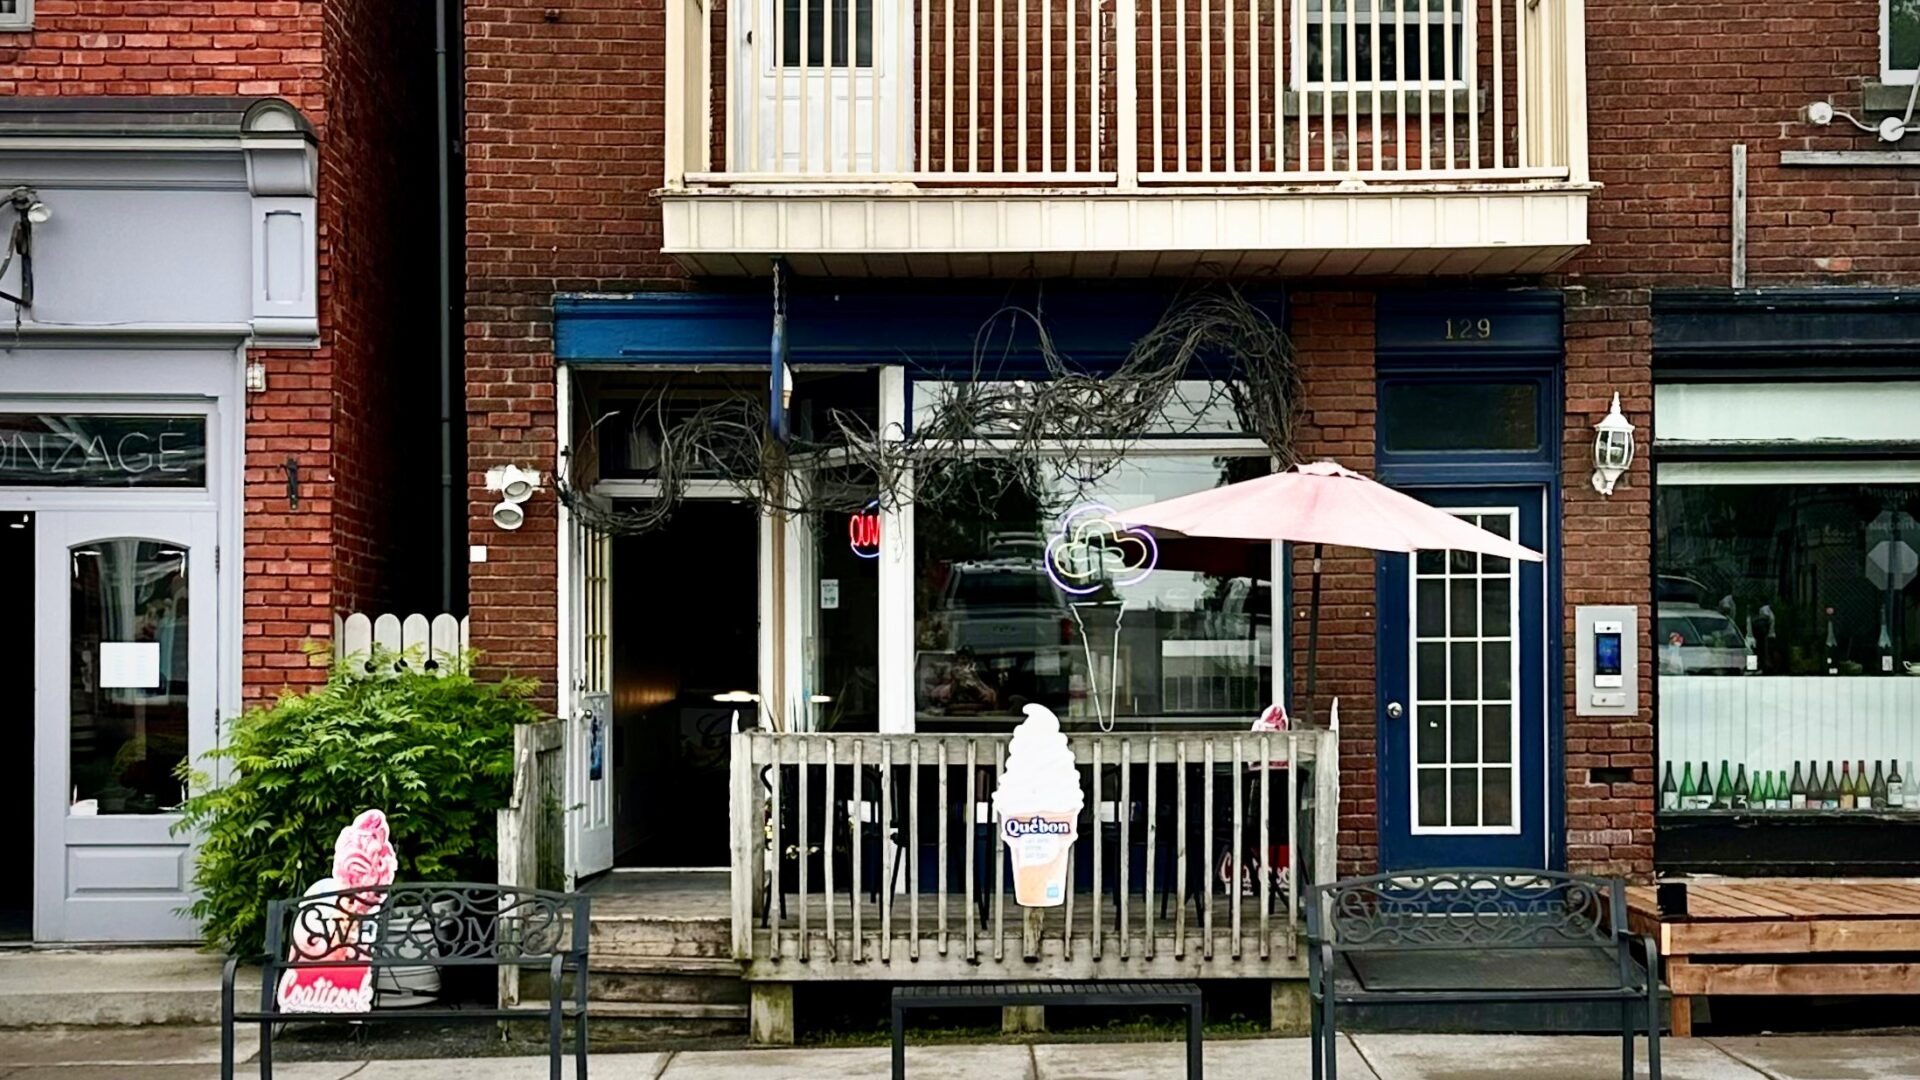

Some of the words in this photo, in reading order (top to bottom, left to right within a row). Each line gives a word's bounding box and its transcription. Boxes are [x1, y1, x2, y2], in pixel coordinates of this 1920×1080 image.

[1445, 318, 1491, 340] 129
[0, 432, 187, 473] NZAGE
[1005, 817, 1070, 837] Québon
[321, 915, 527, 947] WELCOME
[278, 967, 373, 1009] Coaticook
